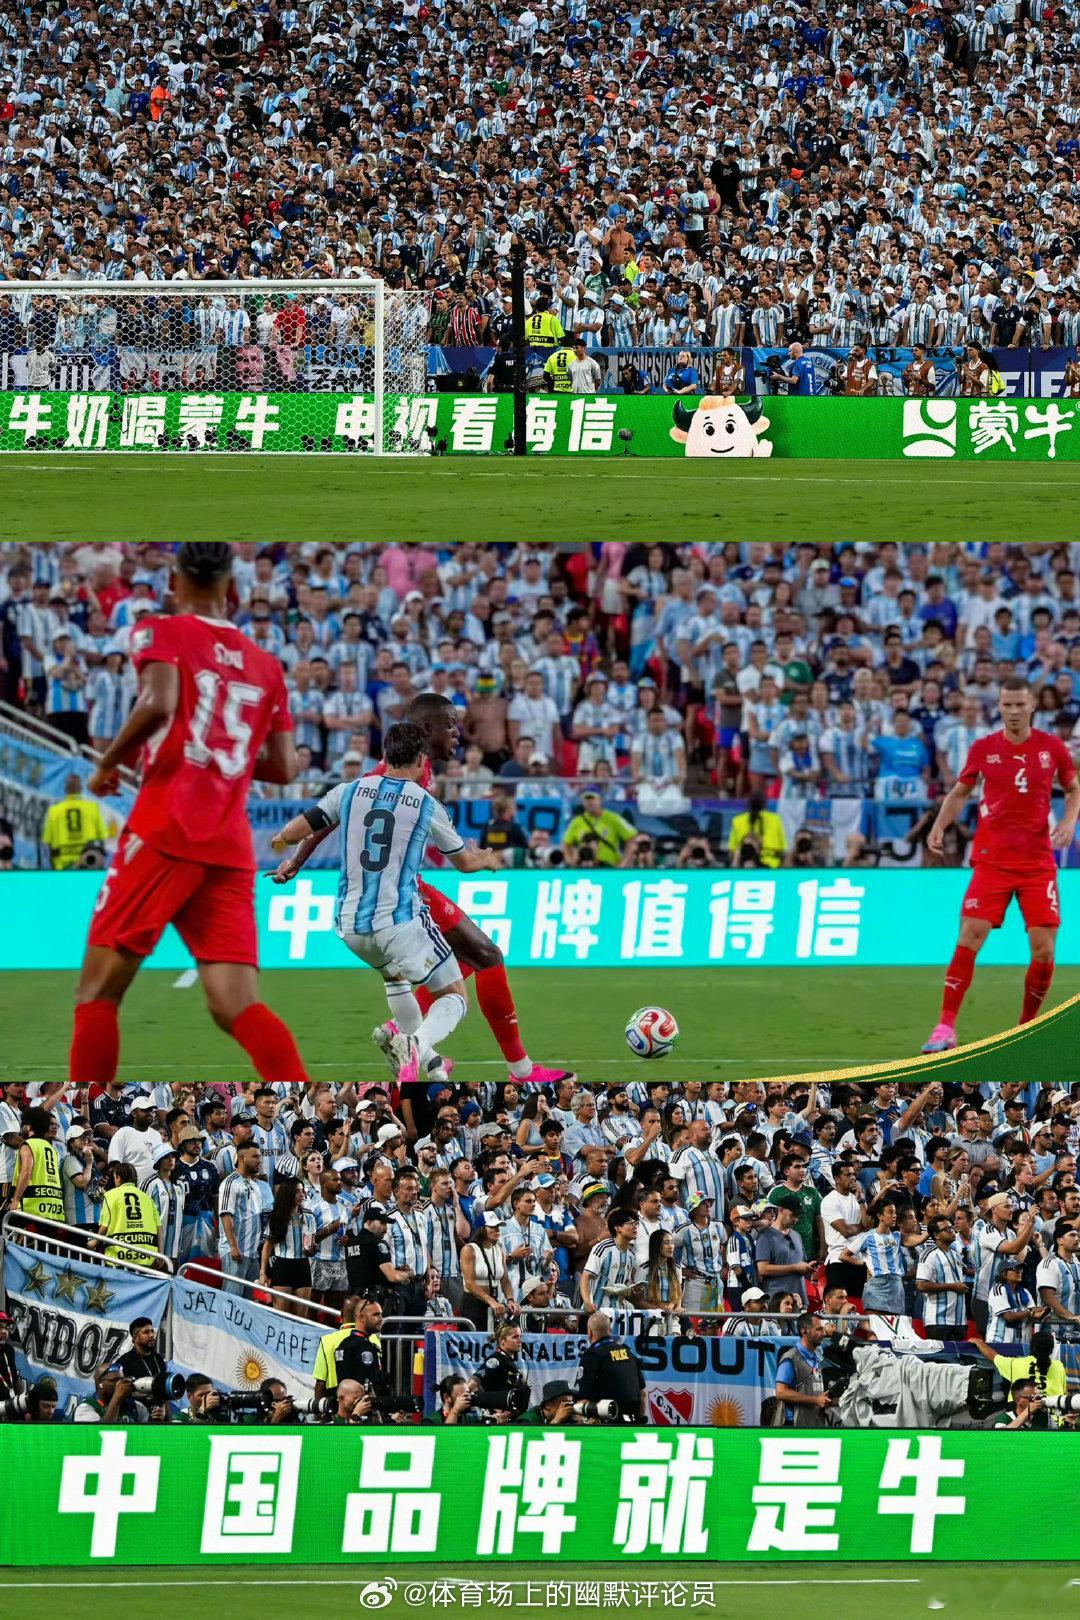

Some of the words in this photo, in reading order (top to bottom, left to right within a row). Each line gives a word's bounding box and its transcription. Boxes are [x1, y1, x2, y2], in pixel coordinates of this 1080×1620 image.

[998, 371, 1074, 398] FIF
[9, 395, 280, 449] 牛奶喝蒙牛
[335, 396, 617, 451] 电视看海信
[969, 400, 1076, 459] 蒙牛
[183, 669, 264, 780] 15
[356, 786, 421, 810] TAGLIAFICO
[1014, 768, 1028, 793] 4
[359, 808, 396, 873] 3
[267, 878, 865, 960] 中品牌值得信
[183, 1291, 217, 1314] JAZ
[609, 1348, 630, 1362] POLICE
[634, 1335, 796, 1377] SOUT
[57, 1430, 966, 1558] 中国品牌就是牛
